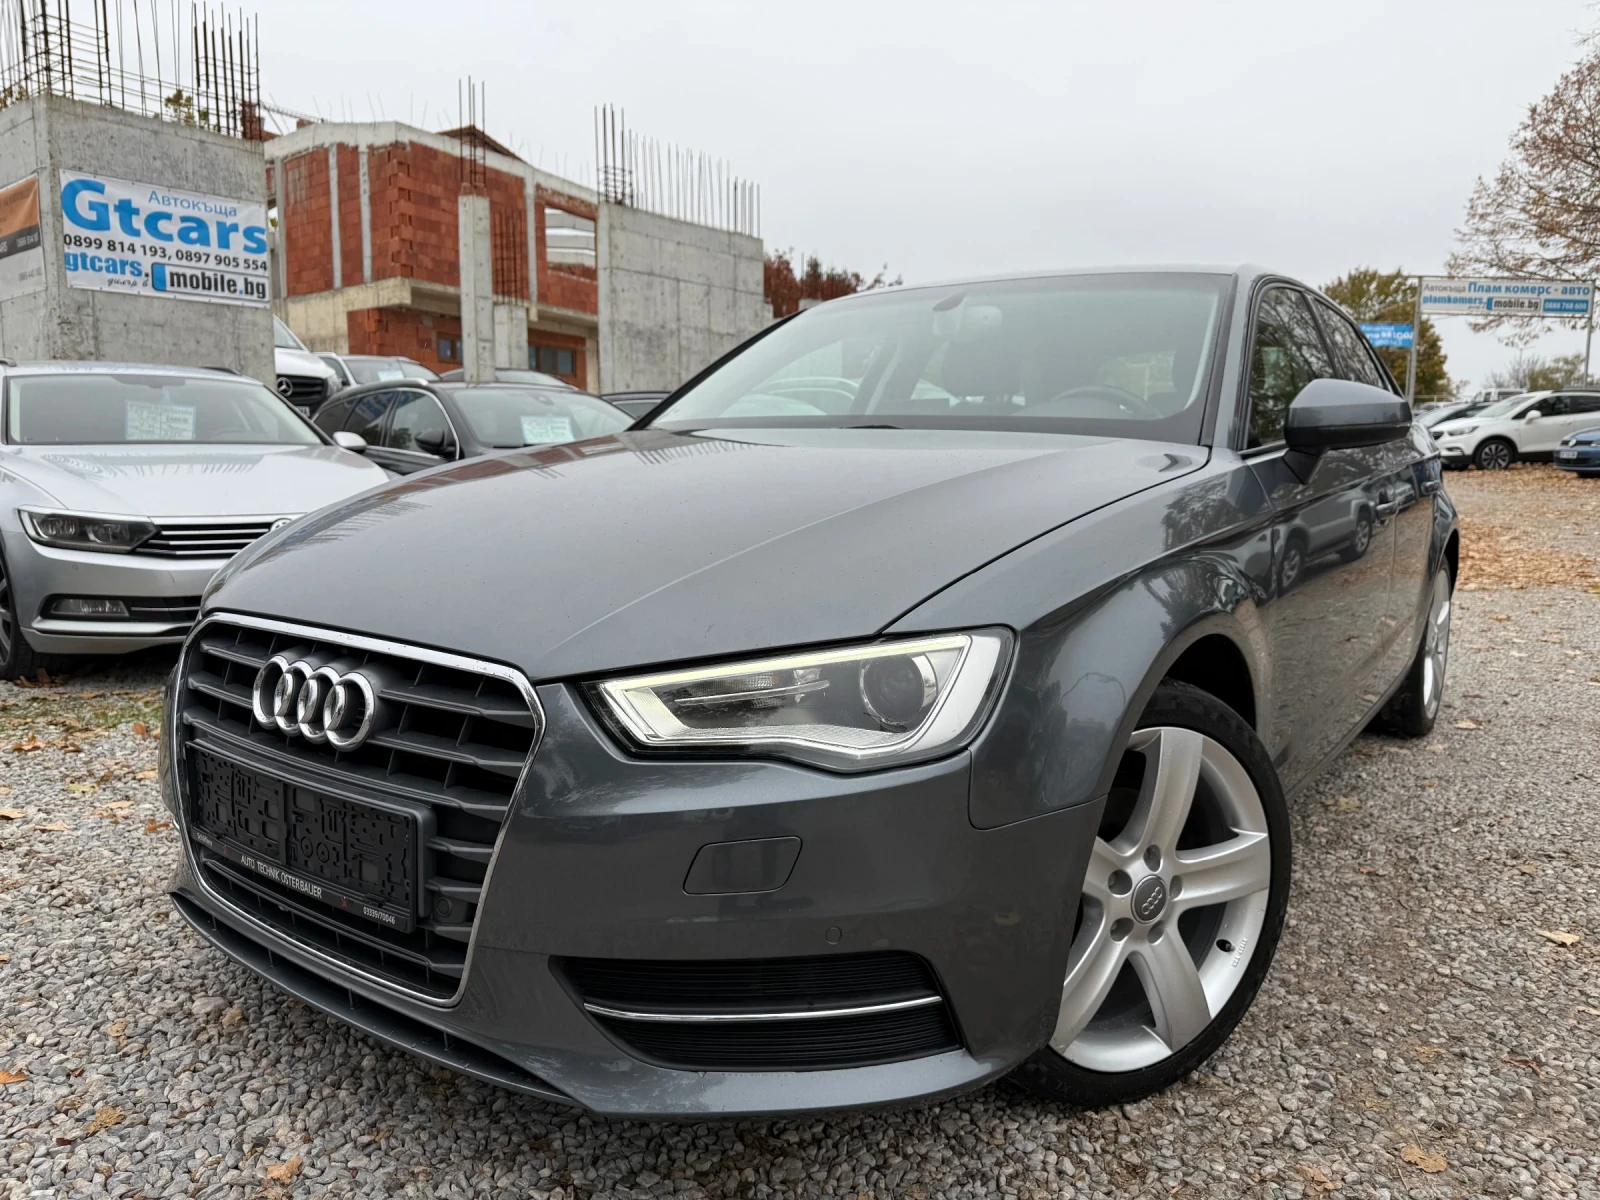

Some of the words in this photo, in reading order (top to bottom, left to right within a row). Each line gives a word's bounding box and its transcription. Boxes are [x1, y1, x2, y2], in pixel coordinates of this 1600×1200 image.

[61, 178, 267, 255] Gtcars
[148, 190, 238, 218] Автокъща
[63, 233, 103, 250] 0899
[107, 239, 136, 255] 814
[140, 244, 172, 261] 193,
[175, 249, 210, 264] 0897
[214, 253, 240, 268] 905
[243, 259, 268, 272] 554
[169, 270, 266, 299] mobile.bg
[1423, 283, 1466, 293] Автокъща
[1468, 281, 1502, 293] Плам
[1505, 285, 1552, 297] комерс
[1561, 285, 1590, 296] авто
[1493, 300, 1539, 310] mobile.bg
[240, 855, 255, 869] AUTO
[256, 861, 280, 881] TECHNIK
[280, 871, 323, 899] OSTERBAUER
